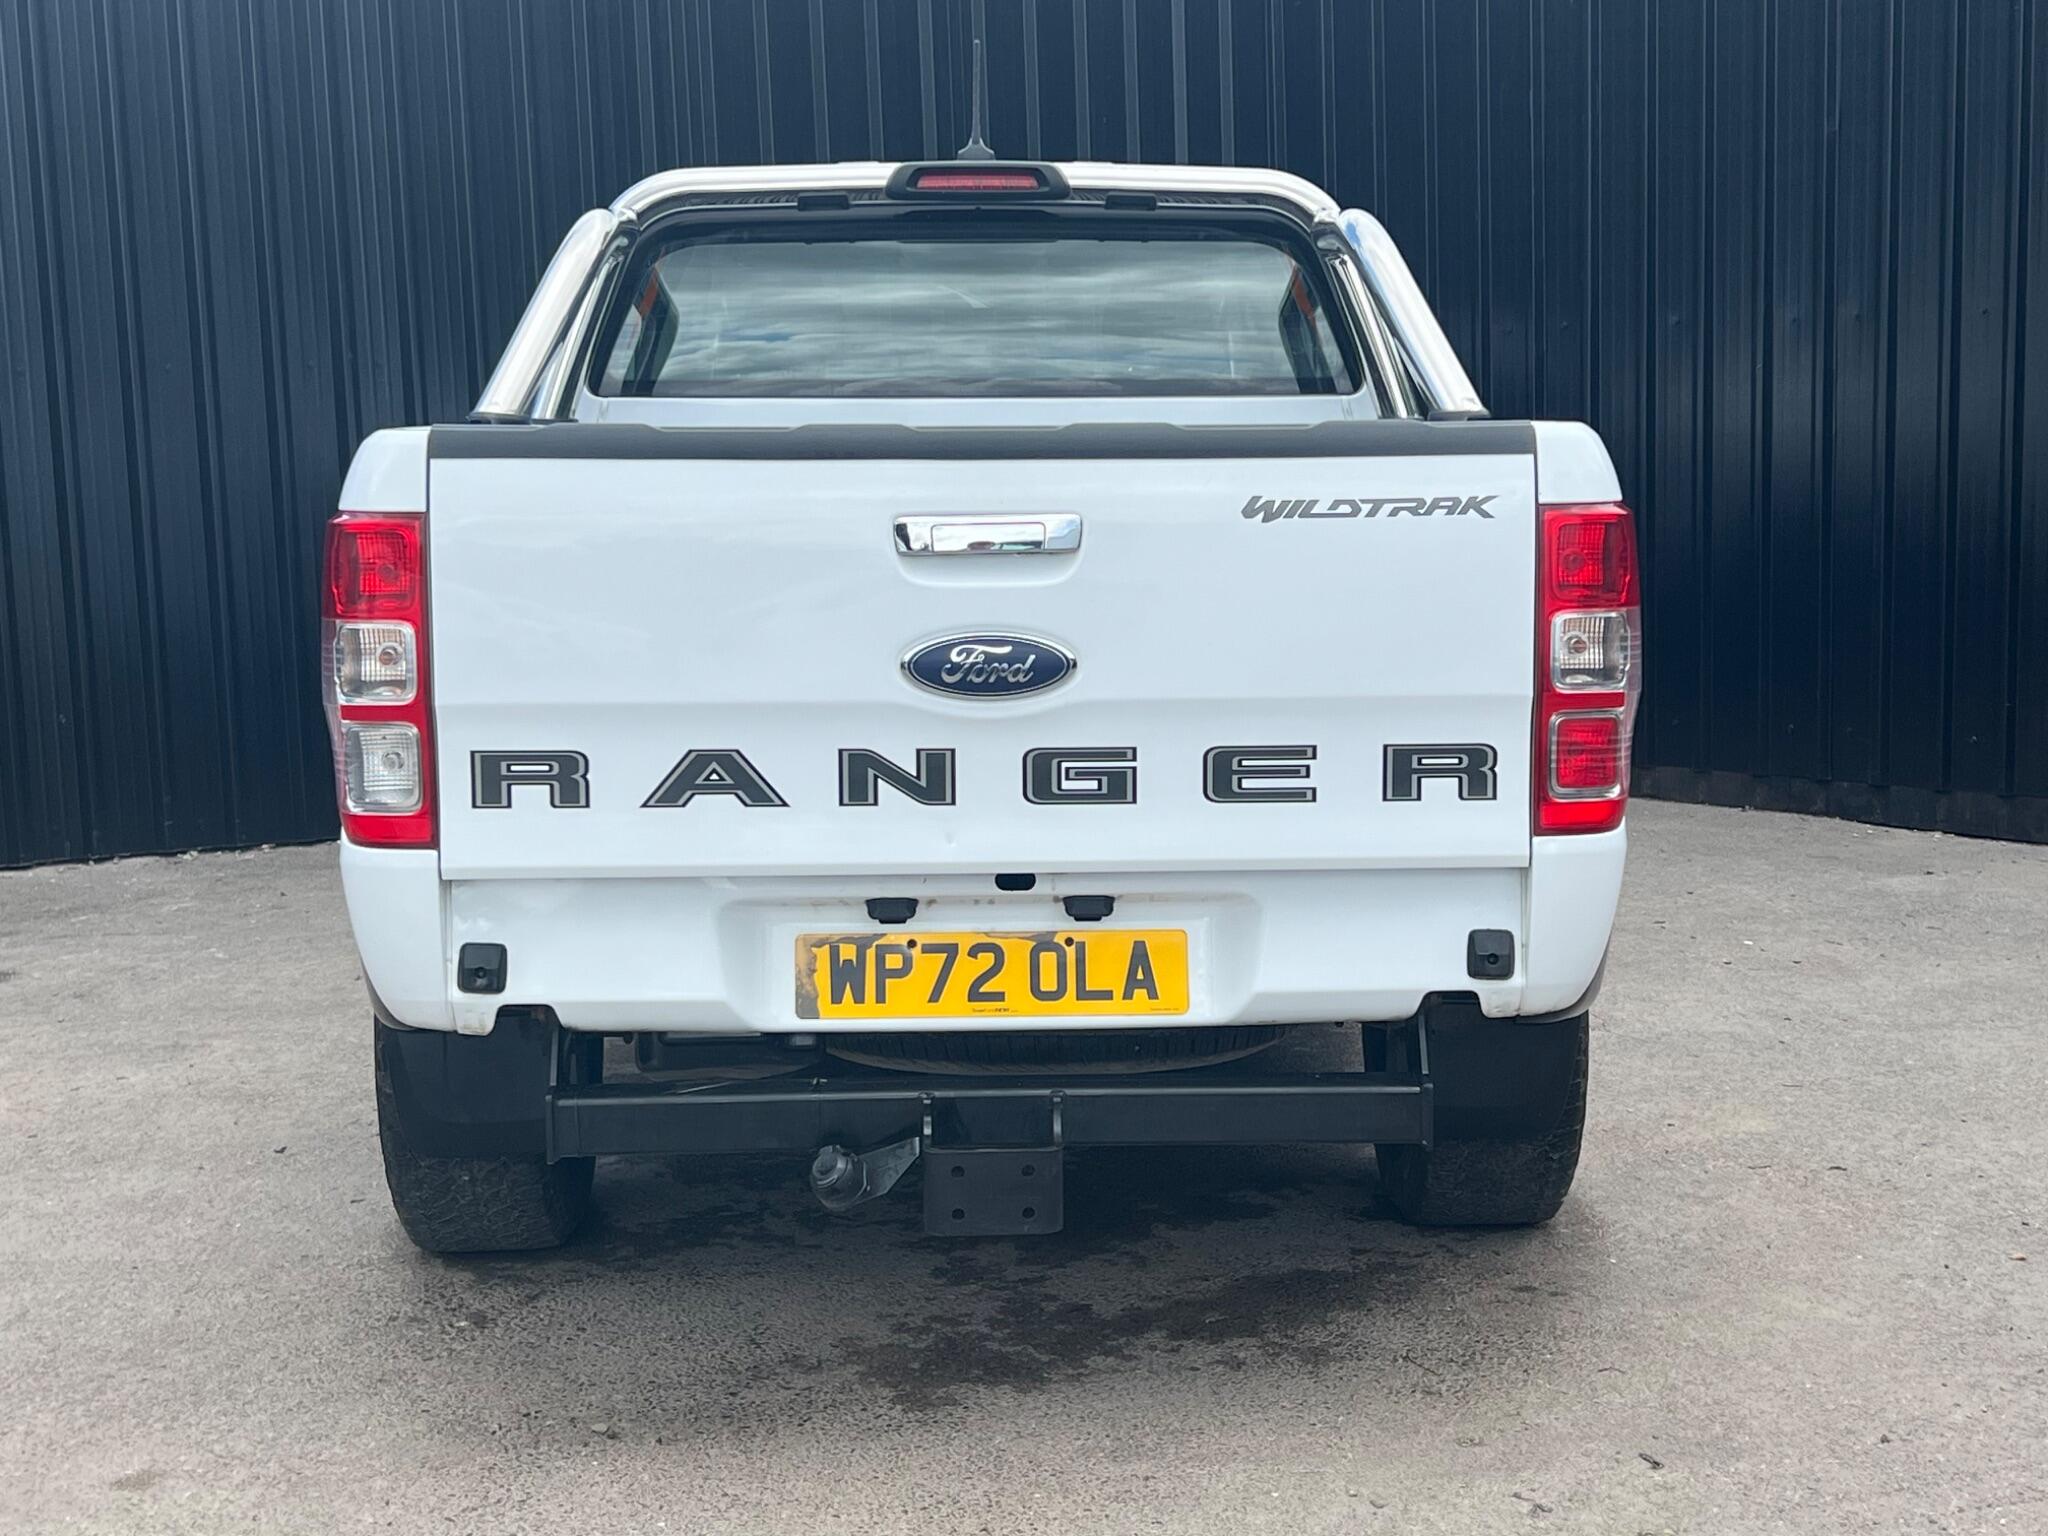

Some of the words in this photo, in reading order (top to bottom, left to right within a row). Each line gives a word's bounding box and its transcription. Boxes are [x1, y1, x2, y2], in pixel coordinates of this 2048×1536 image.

[1241, 495, 1498, 523] WILDTRAK
[940, 644, 1035, 686] Ford
[470, 744, 1498, 809] RANGER
[828, 942, 1006, 1005] WP72
[1030, 940, 1160, 1001] OLA
